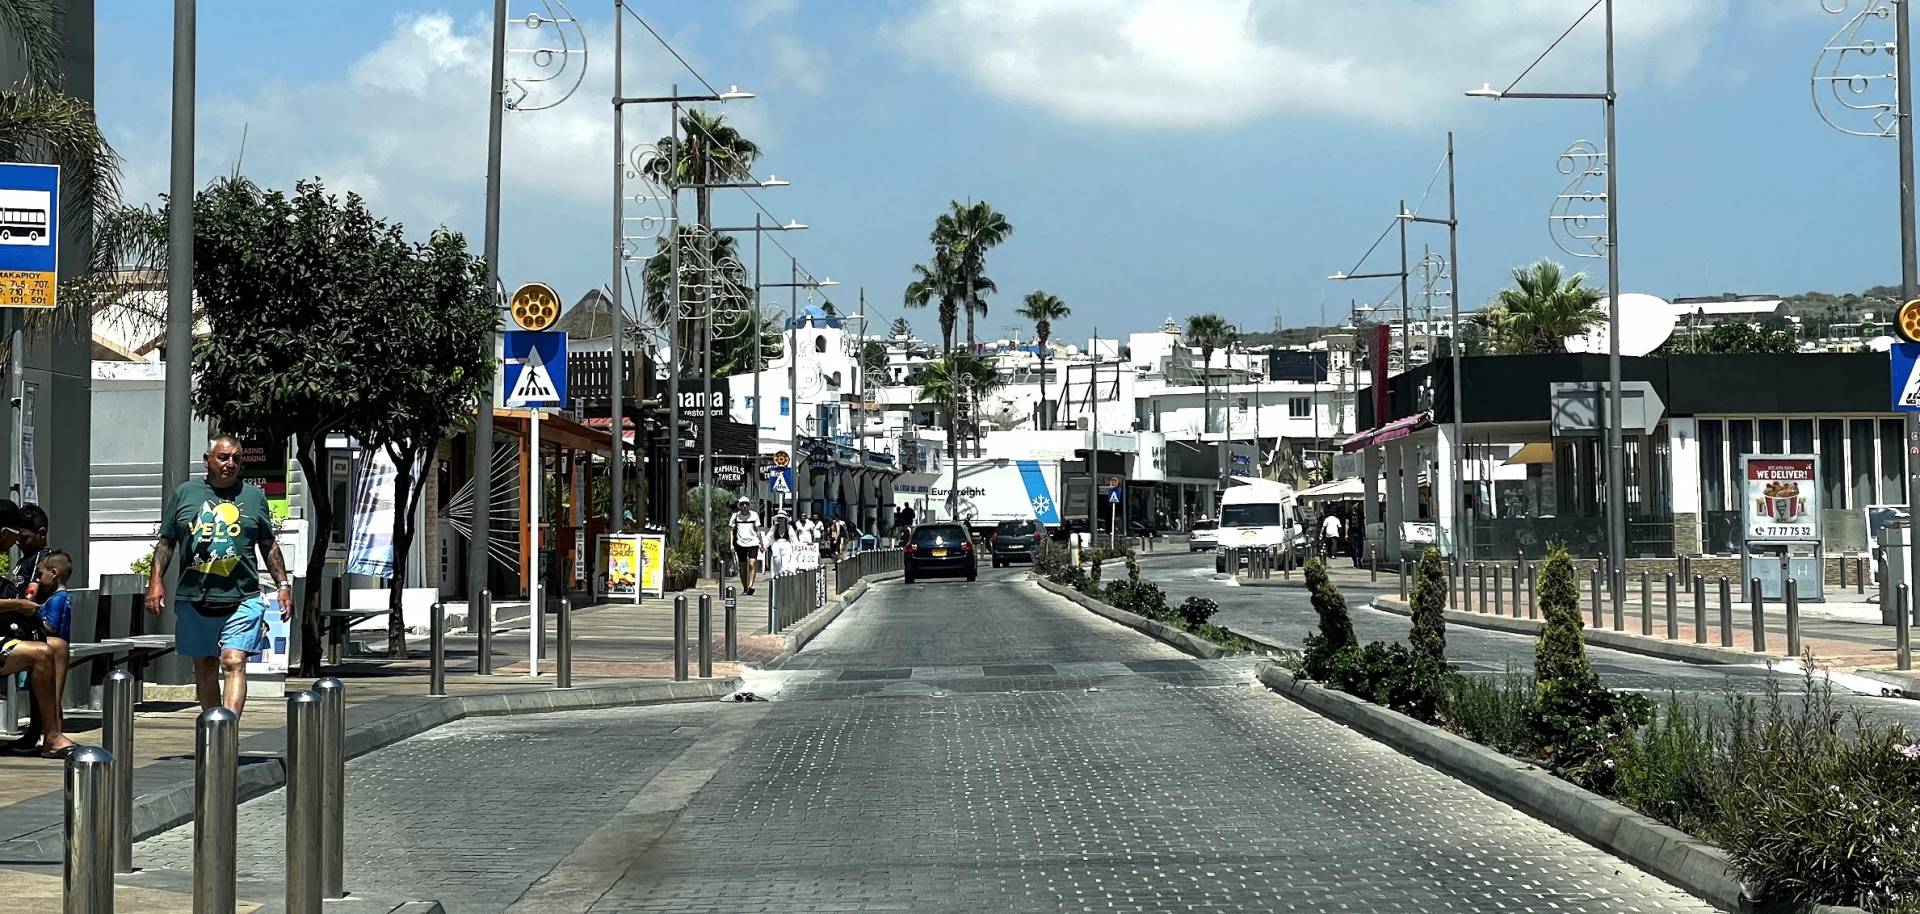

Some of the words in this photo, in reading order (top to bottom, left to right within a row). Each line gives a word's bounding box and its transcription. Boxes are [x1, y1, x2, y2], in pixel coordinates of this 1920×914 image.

[31, 296, 46, 304] 501
[684, 409, 724, 417] restaant
[713, 465, 745, 475] RAPHAELS
[1756, 470, 1769, 479] WE
[1771, 470, 1808, 479] DELIVER!
[718, 473, 741, 481] TAVERN
[931, 486, 986, 499] Euroreight
[188, 521, 241, 537] VELO
[1767, 526, 1777, 536] 77
[1778, 526, 1788, 536] 77
[1789, 526, 1800, 536] 75
[1801, 526, 1811, 536] 32
